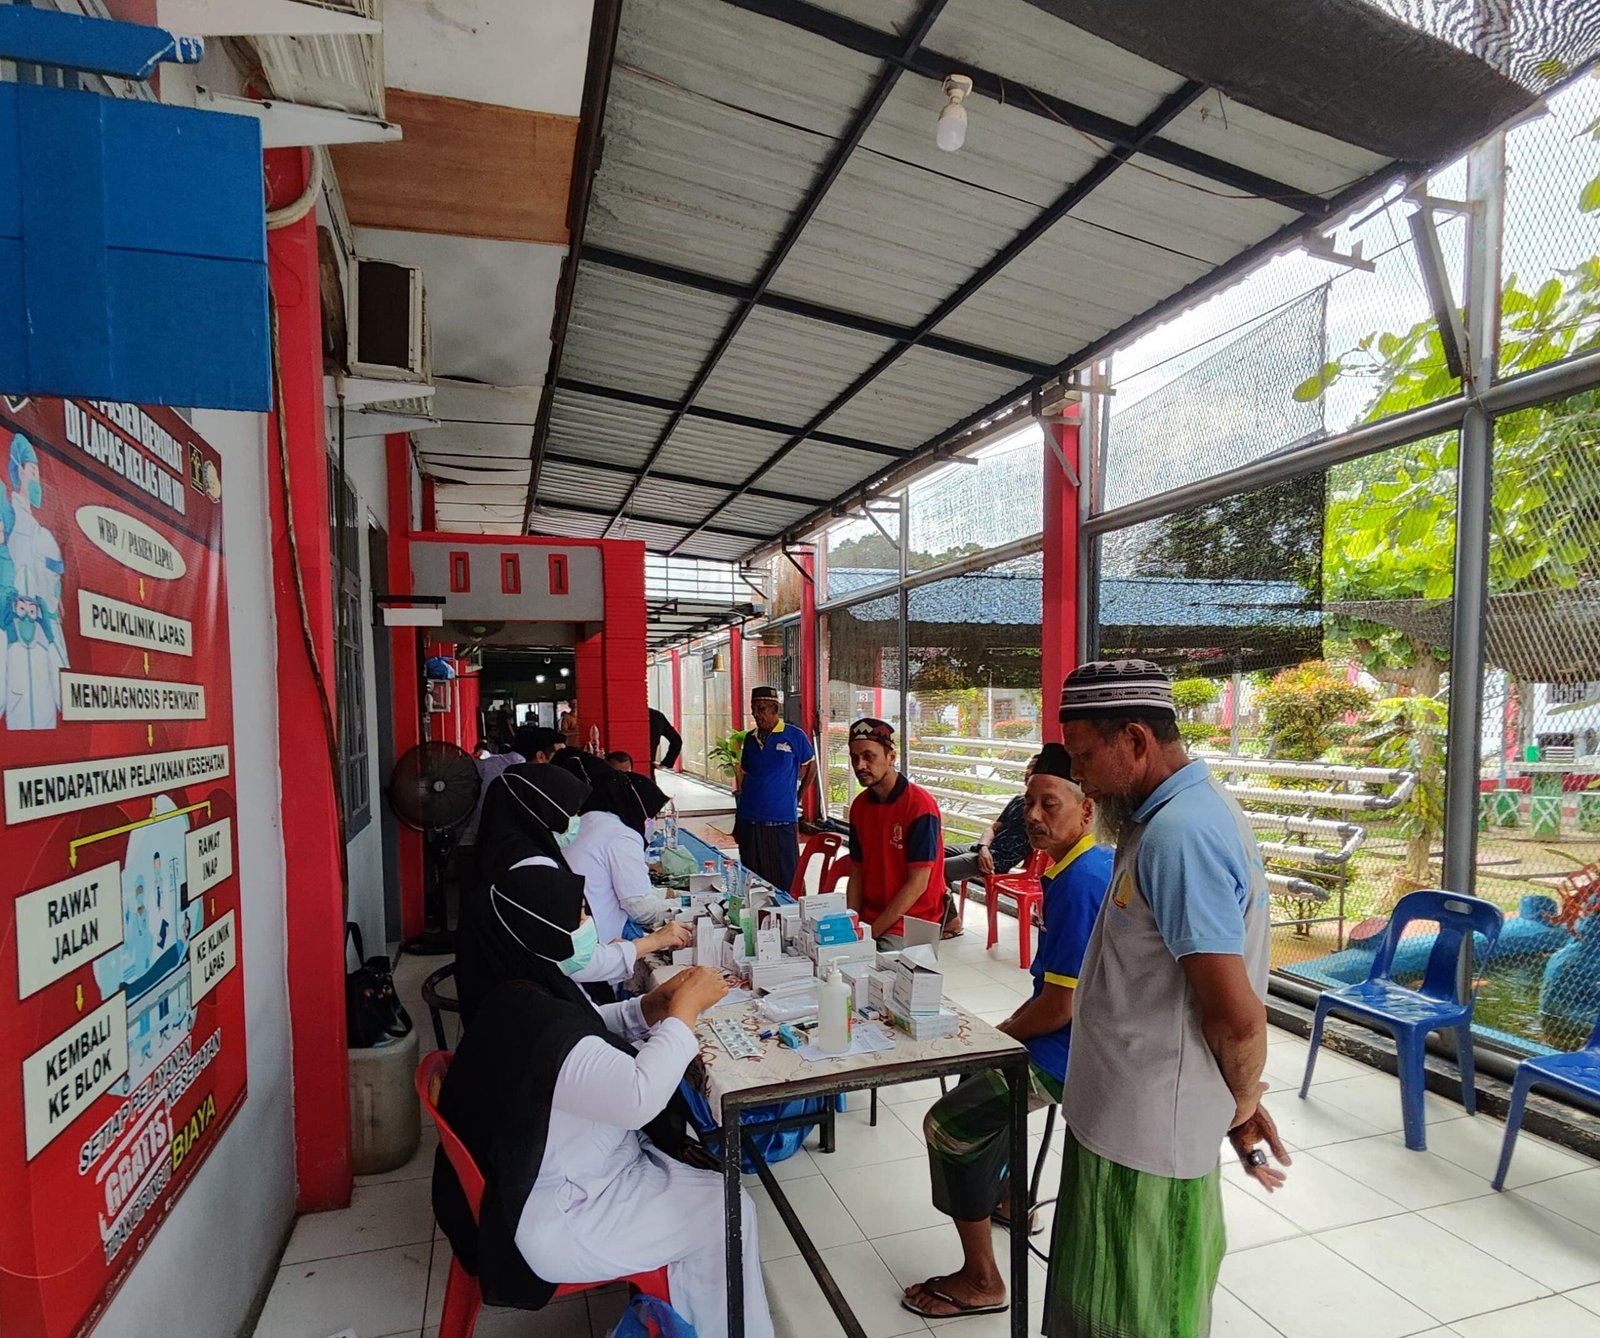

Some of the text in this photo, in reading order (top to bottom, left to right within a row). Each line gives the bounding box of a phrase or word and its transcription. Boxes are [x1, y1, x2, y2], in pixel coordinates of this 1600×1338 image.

[64, 398, 82, 448] DI
[82, 410, 125, 476] LAPAS
[124, 442, 158, 498] KELAS
[97, 515, 118, 546] WBP
[128, 530, 153, 562] PASIEN
[153, 543, 174, 571] LAPAS
[92, 604, 185, 647] POLIKLINIK LAPAS
[70, 682, 199, 711] MENDIAGNOSIS PENYAKIT
[19, 753, 225, 809] MENDAPATKAN PELAYANAN KESEHATAN
[198, 831, 221, 858] RAWAT
[203, 857, 218, 881] INAP
[48, 882, 99, 928] RAWAT
[52, 918, 99, 965] JALAN
[197, 922, 230, 964] KE KLINIK
[204, 950, 225, 984] LAPAS
[46, 1014, 112, 1087] KEMBALI
[165, 1027, 221, 1107] KESEHATAN
[49, 1049, 113, 1124] KE BLOK
[79, 1035, 192, 1176] SETIAP PELAYANAN
[171, 1094, 216, 1172] BIAYA
[105, 1109, 167, 1217] GRATIS
